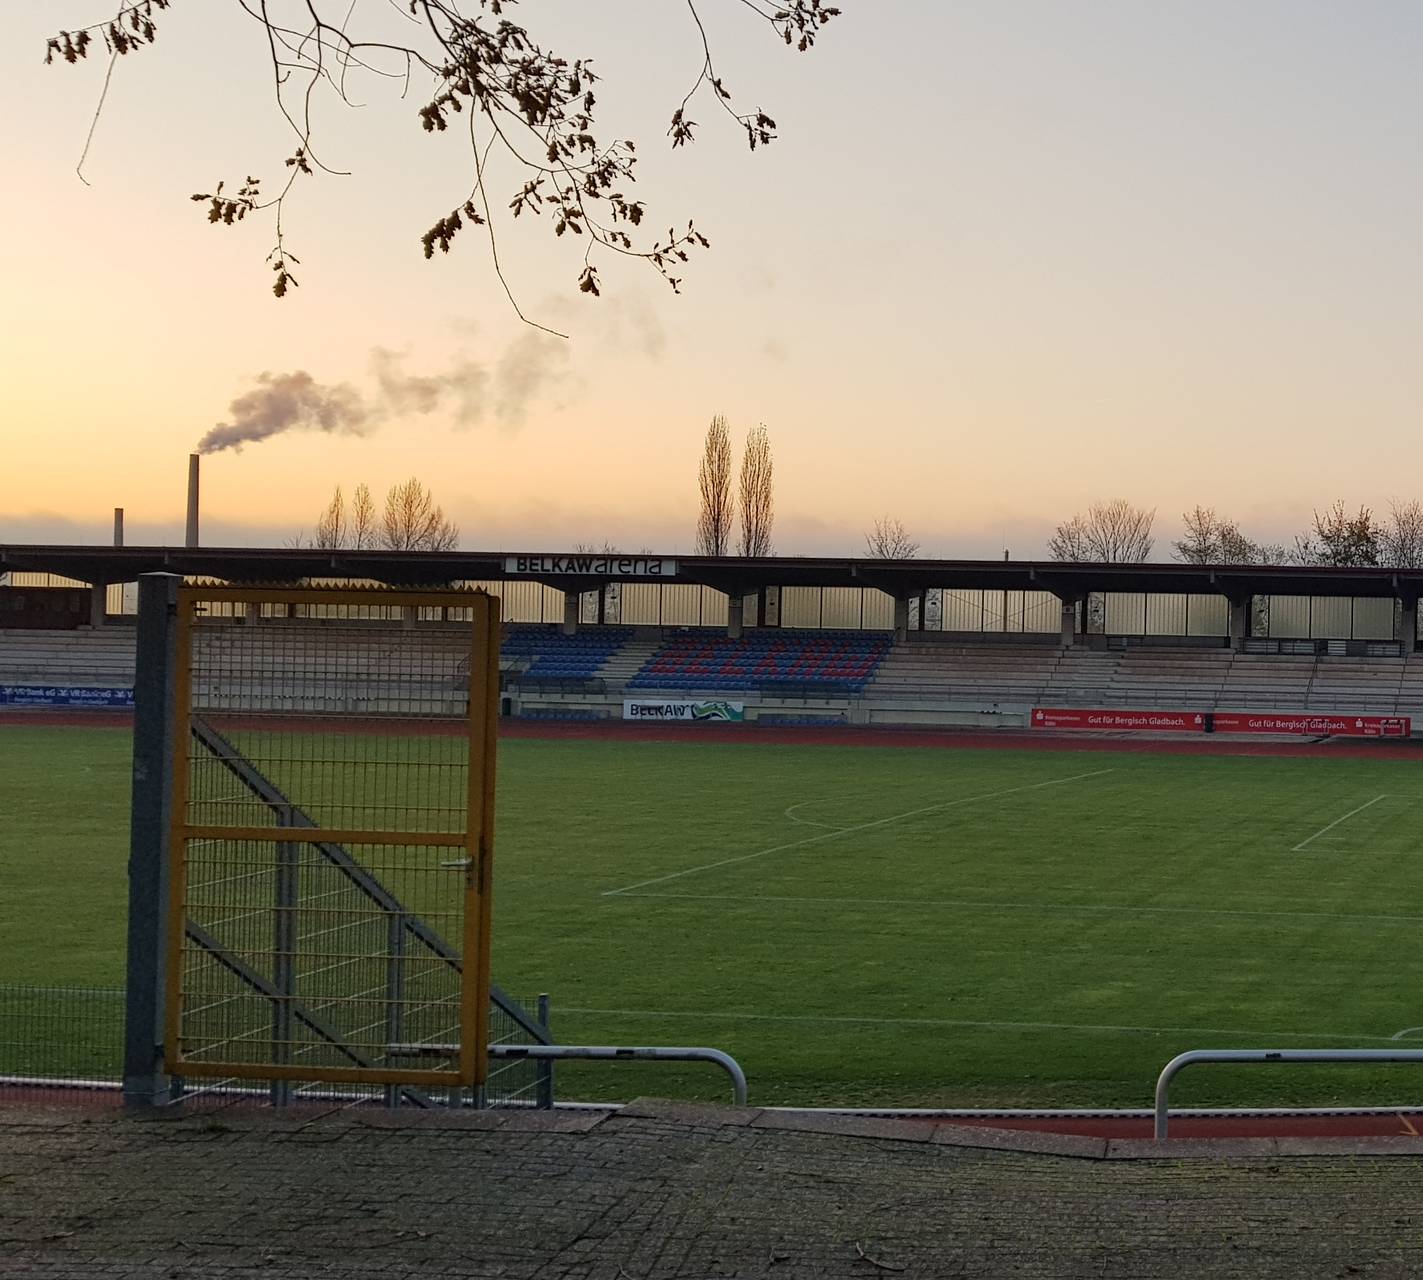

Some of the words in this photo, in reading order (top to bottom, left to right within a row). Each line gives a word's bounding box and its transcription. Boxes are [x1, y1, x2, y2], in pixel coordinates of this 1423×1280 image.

[1088, 716, 1102, 724] Gut
[1103, 716, 1114, 725] für
[1115, 716, 1148, 726] Bergisch
[1149, 718, 1186, 726] Gladbach.
[1248, 719, 1262, 728] Gut
[1263, 719, 1275, 728] für
[1276, 720, 1309, 730] Bergisch
